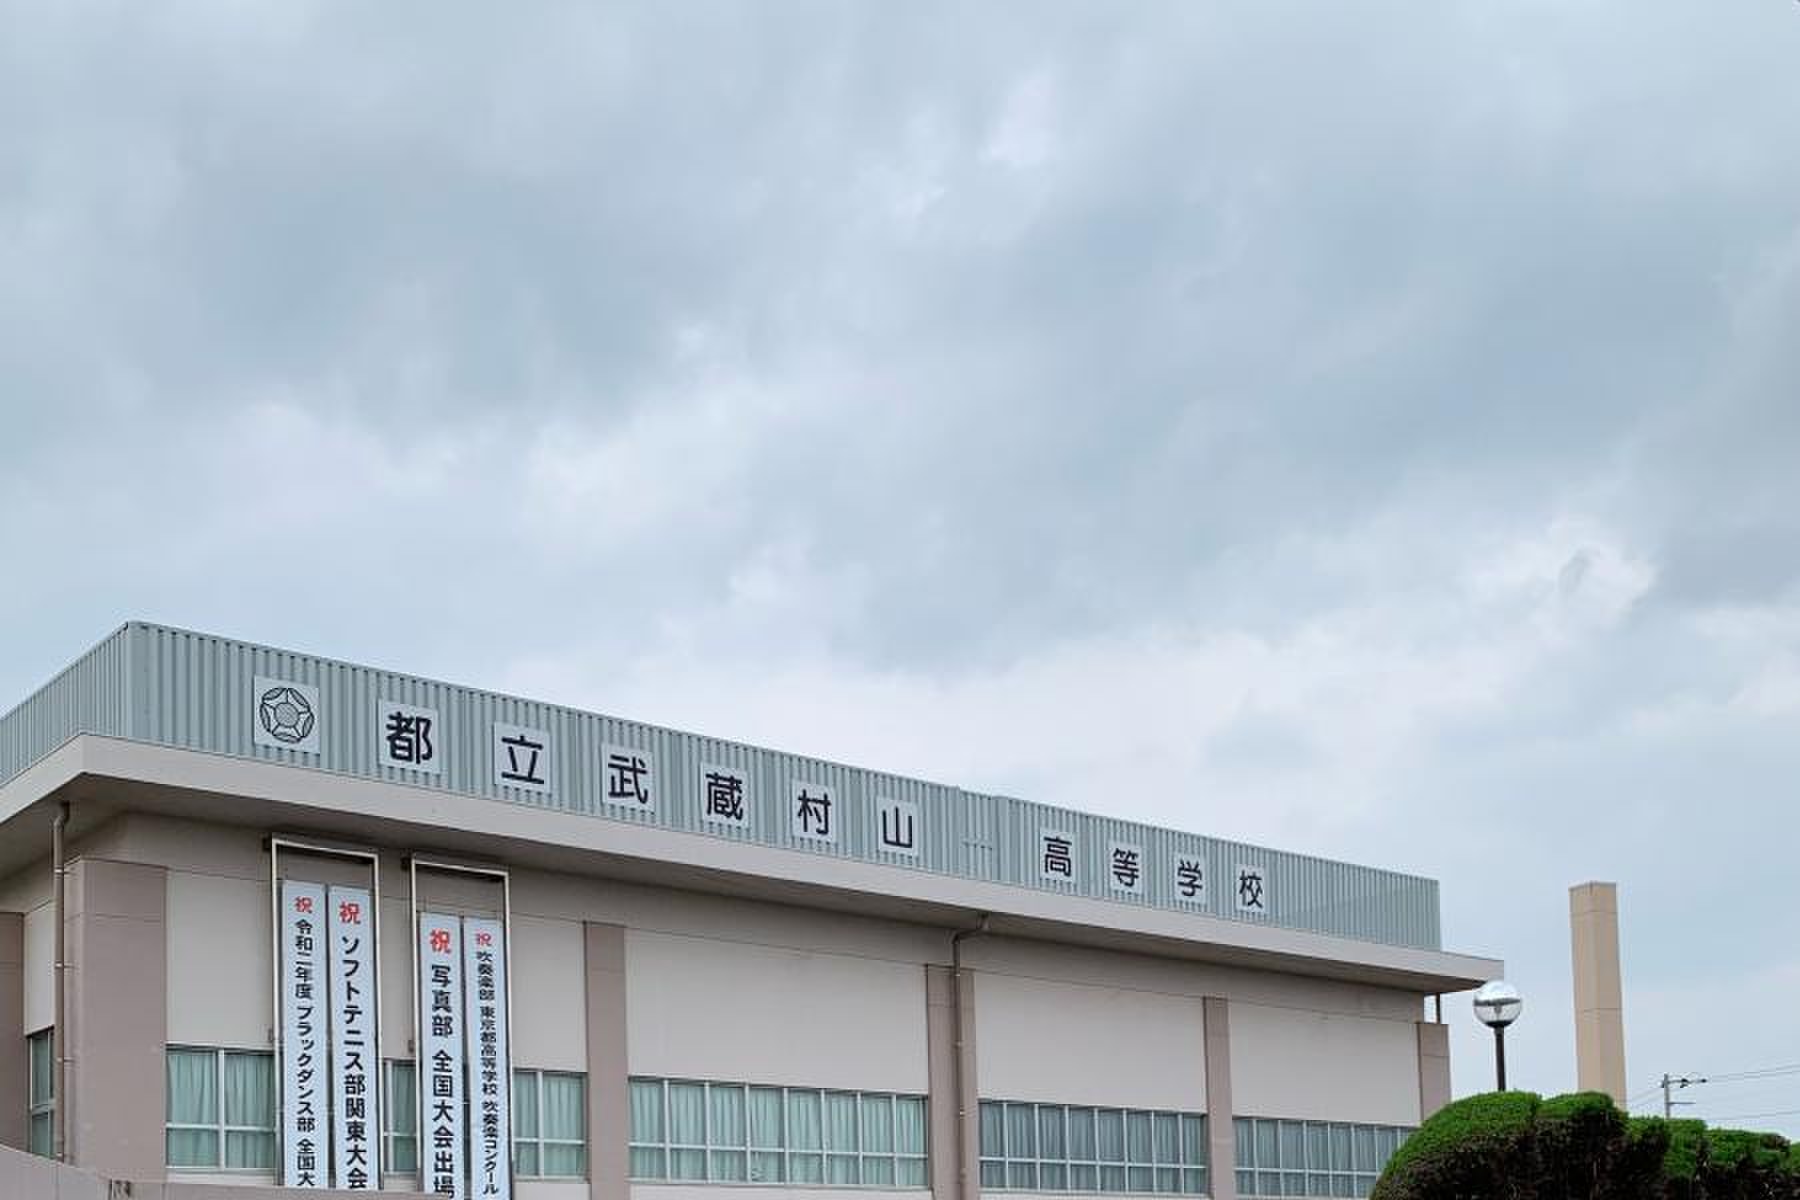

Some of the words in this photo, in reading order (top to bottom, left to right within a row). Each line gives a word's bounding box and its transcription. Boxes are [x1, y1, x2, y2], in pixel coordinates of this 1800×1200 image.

[295, 896, 314, 915] 祝
[339, 901, 361, 925] 祝
[430, 929, 452, 955] 祝
[431, 964, 454, 1038] 写真部
[341, 936, 368, 1190] ソフトテニス部関東大会
